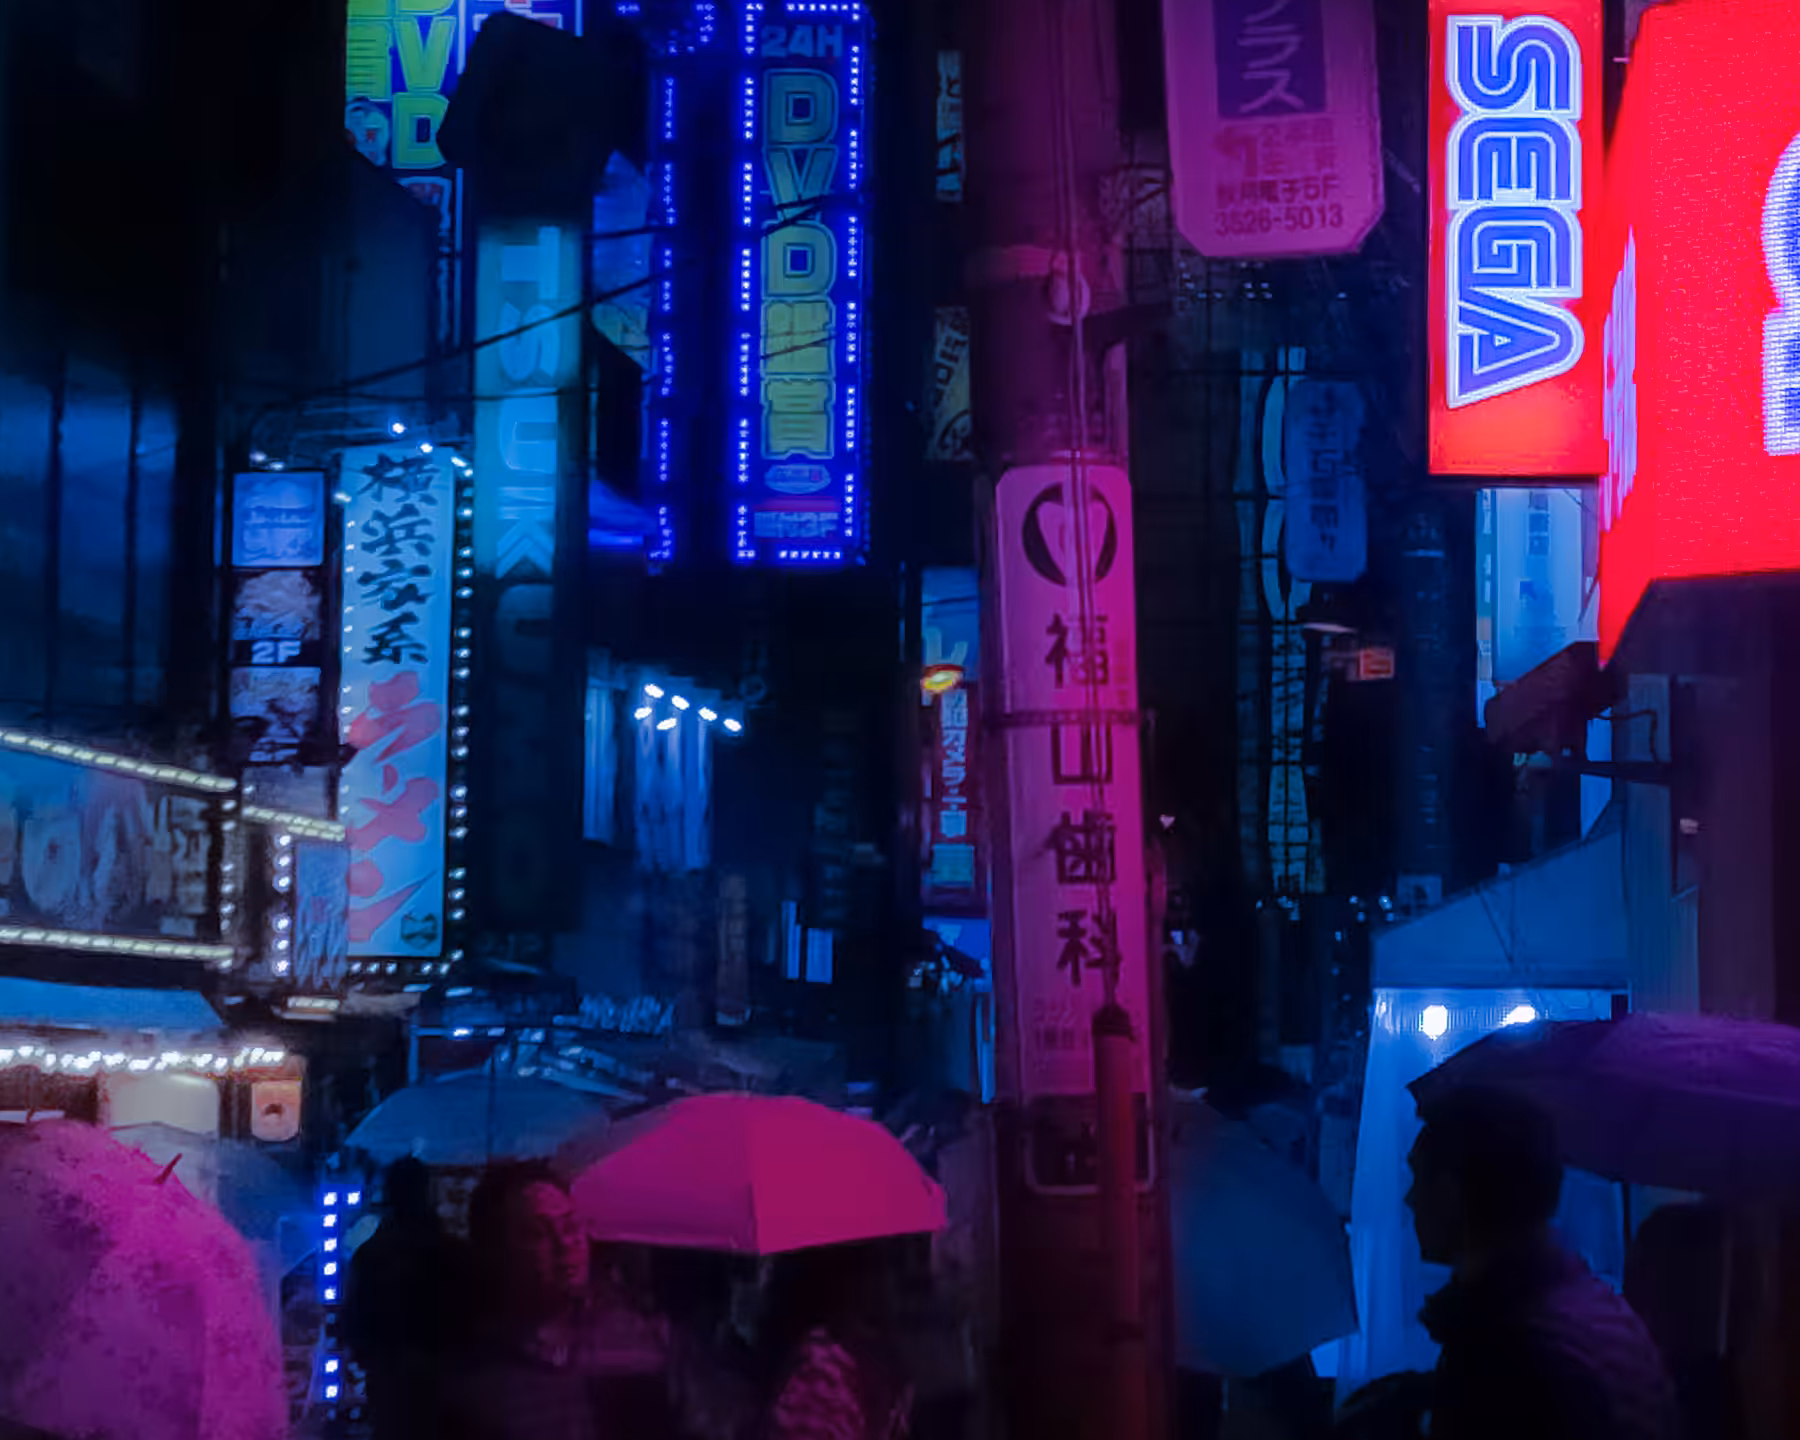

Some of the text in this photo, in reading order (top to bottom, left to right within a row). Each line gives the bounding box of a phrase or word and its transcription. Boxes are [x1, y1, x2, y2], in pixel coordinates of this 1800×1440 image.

[760, 24, 844, 58] 24H
[1446, 15, 1585, 410] SEGA
[250, 640, 301, 664] 2F
[1044, 613, 1121, 988] 福山歯科
